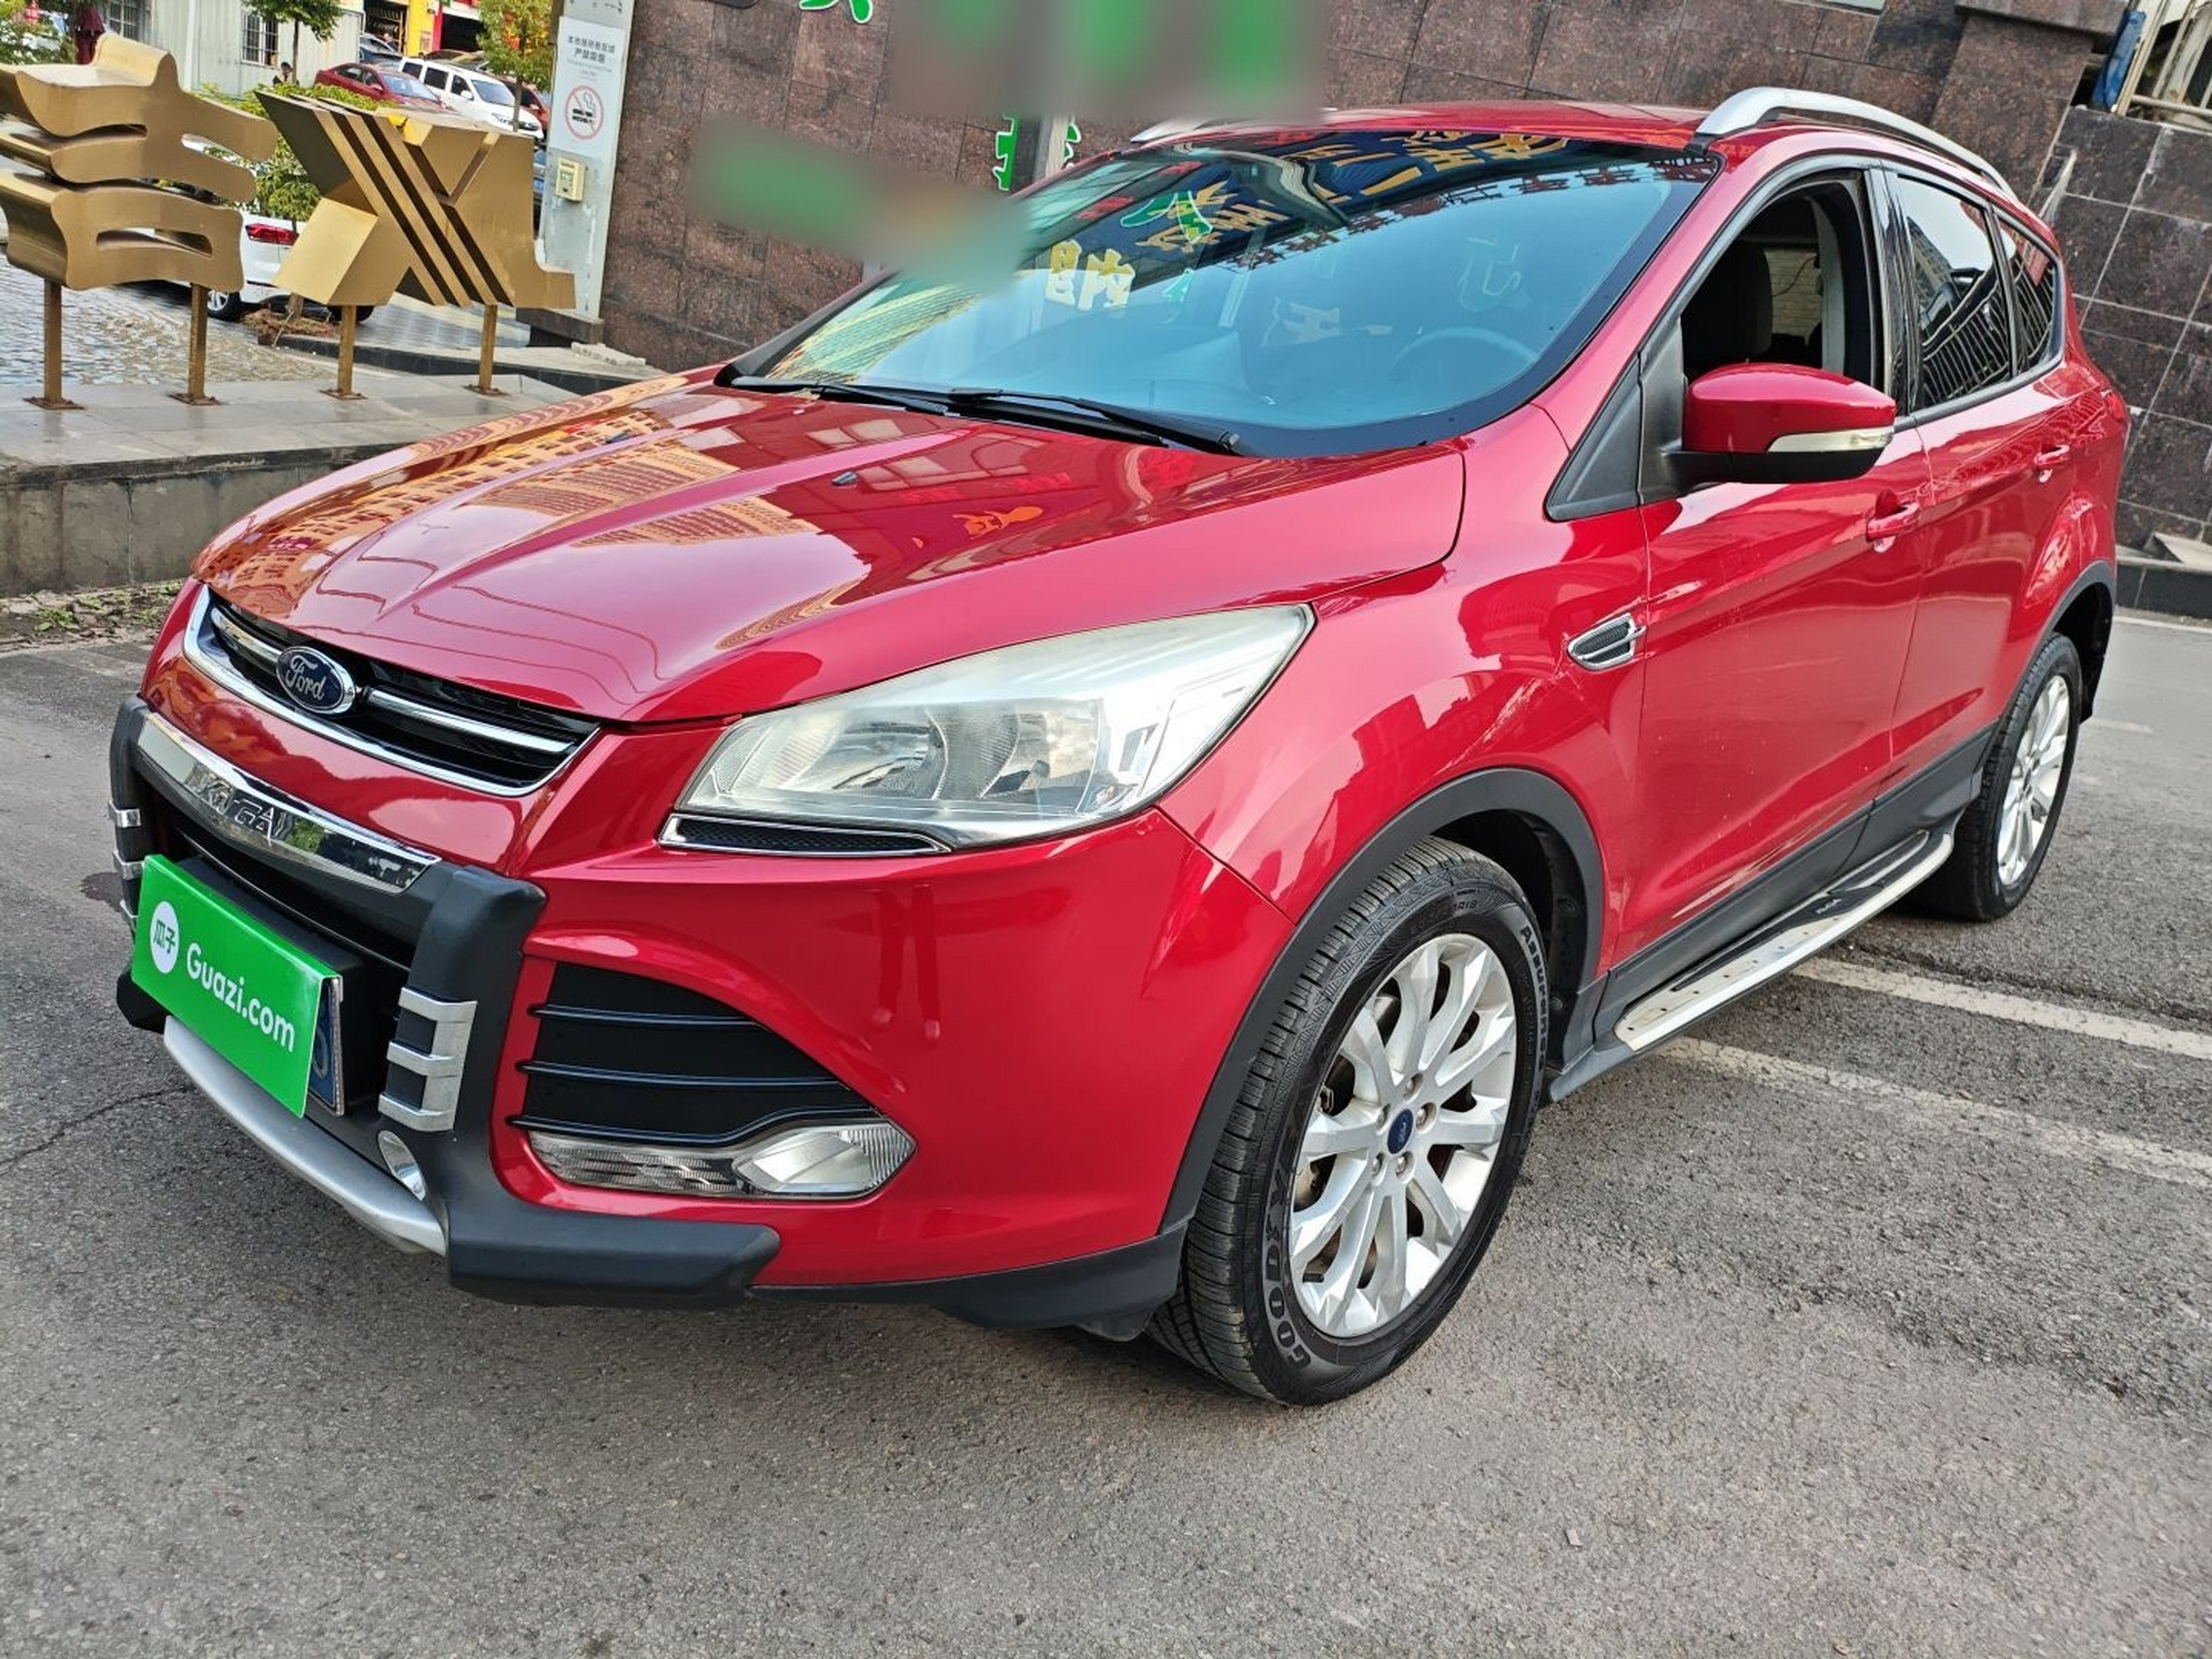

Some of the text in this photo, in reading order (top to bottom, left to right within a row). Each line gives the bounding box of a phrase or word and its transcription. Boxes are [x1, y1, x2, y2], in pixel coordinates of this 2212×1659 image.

[285, 655, 327, 700] Ford
[153, 919, 175, 954] 瓜子
[187, 942, 296, 1052] Guazi.com
